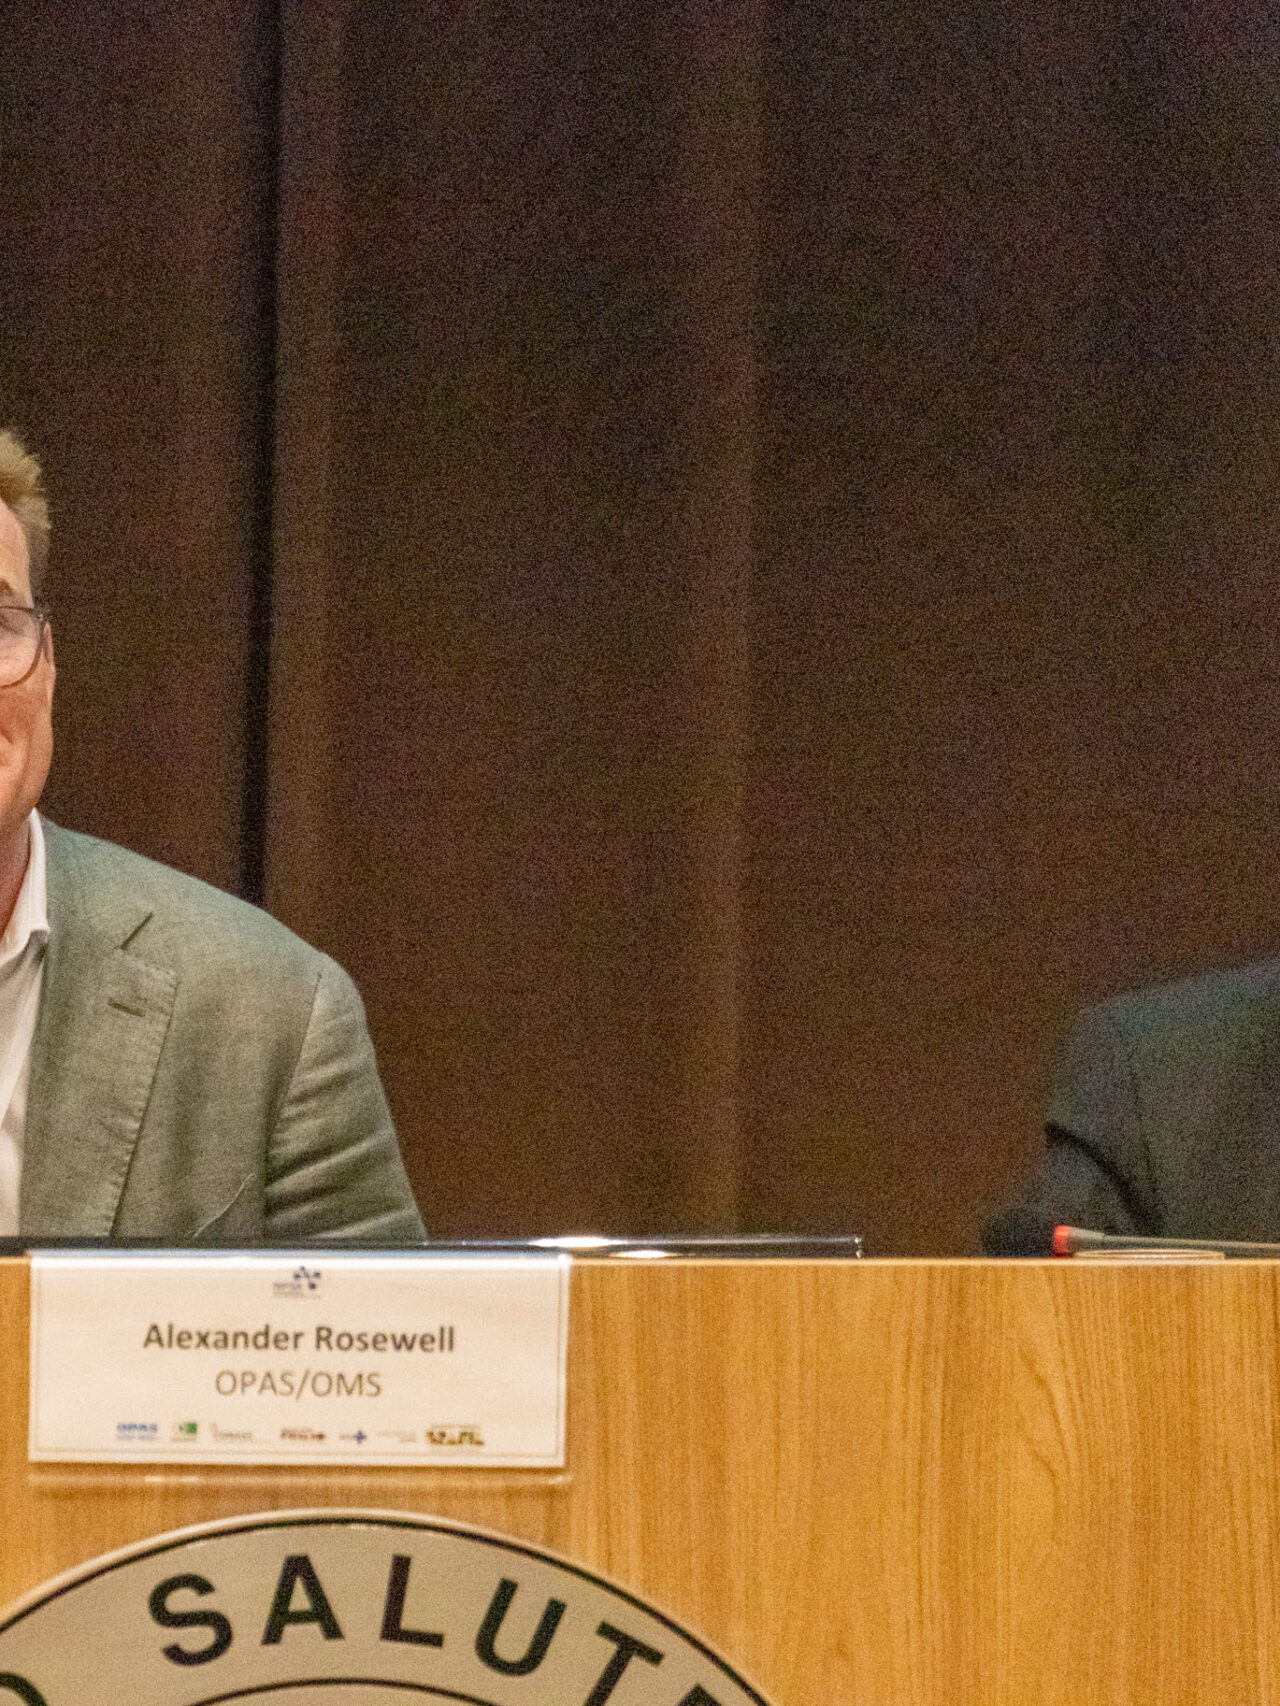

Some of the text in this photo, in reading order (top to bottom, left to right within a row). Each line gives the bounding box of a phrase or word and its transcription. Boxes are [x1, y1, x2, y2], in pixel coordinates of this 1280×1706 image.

[143, 1322, 455, 1352] Alexander Rosewell
[214, 1369, 382, 1401] OPAS/OMS
[148, 1554, 723, 1706] SALUT
